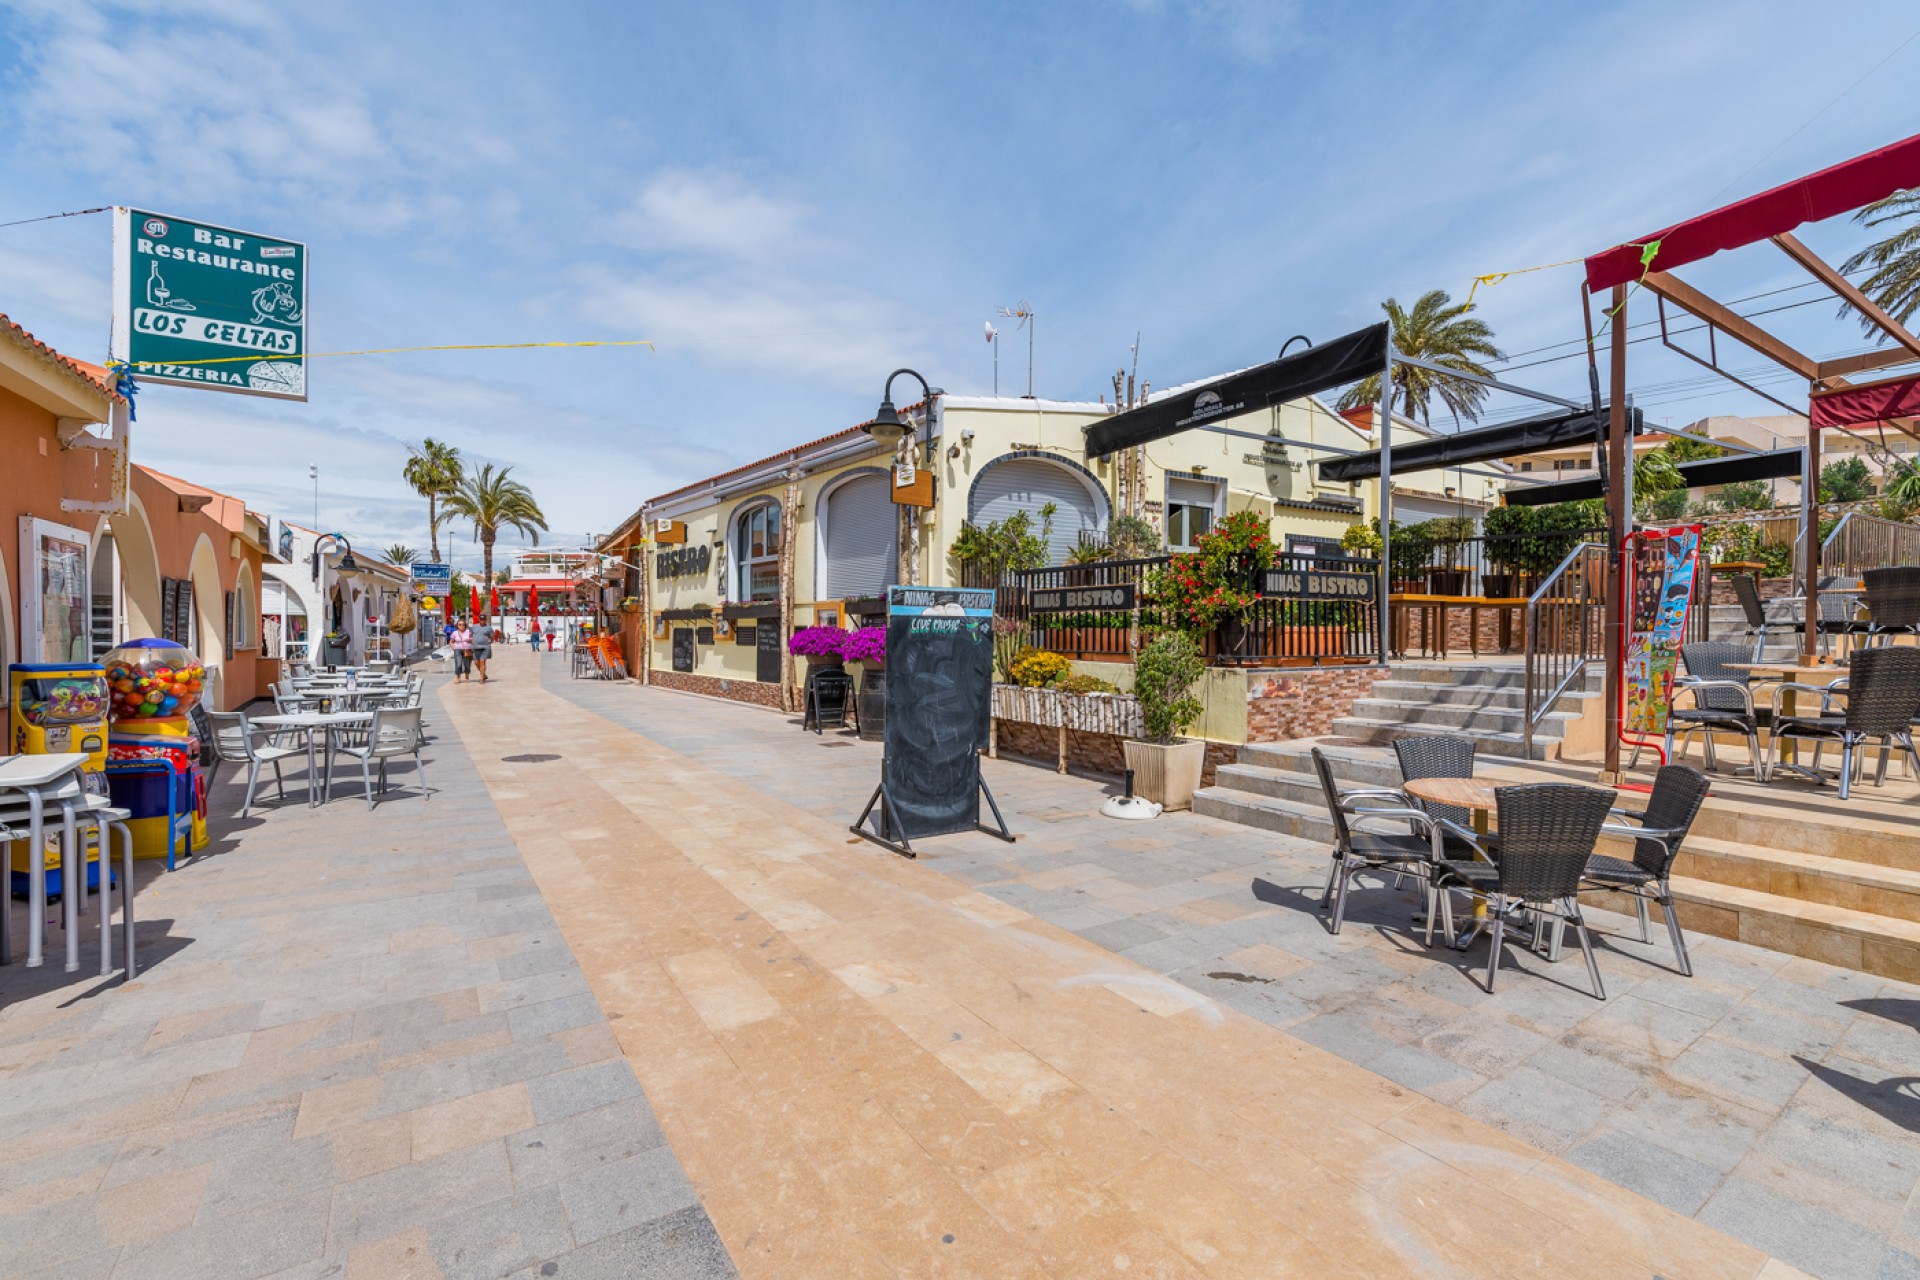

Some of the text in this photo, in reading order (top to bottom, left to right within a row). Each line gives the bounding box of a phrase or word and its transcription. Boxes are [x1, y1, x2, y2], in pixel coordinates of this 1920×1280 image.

[194, 228, 245, 251] Bar
[137, 238, 295, 280] Restaurante
[138, 312, 293, 350] LOS CELTAS
[138, 360, 244, 384] PIZZERIA
[657, 545, 709, 579] BISTRO
[1266, 573, 1368, 595] NINAS BISTRO
[904, 590, 935, 606] NINAS
[1034, 589, 1124, 608] NINAS BISTRO
[912, 618, 931, 631] LIVE
